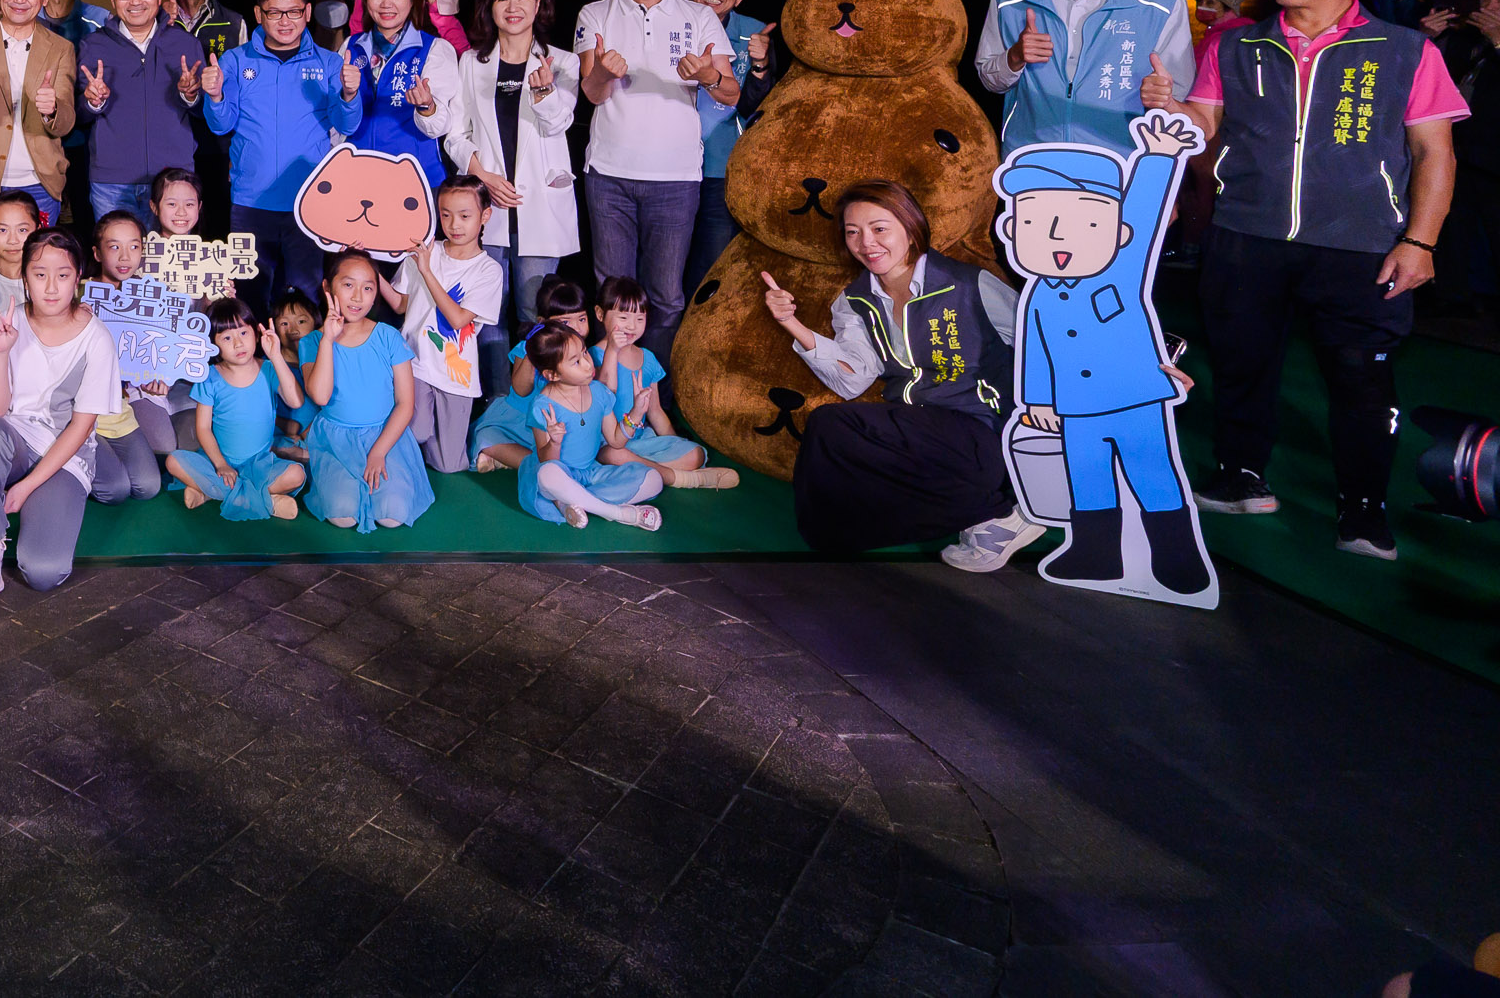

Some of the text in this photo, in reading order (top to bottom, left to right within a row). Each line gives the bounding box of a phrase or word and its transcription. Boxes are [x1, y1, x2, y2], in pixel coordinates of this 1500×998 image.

[390, 61, 408, 107] 陳儀君
[1099, 64, 1115, 100] 黃秀川
[1119, 40, 1136, 90] 新店區長
[1333, 68, 1357, 145] 里長 盧浩賢
[1356, 60, 1380, 143] 新店區 福民里
[141, 235, 254, 274] 碧潭地景
[928, 318, 944, 346] 里長
[943, 308, 962, 350] 新店區
[118, 329, 214, 378] 豚君
